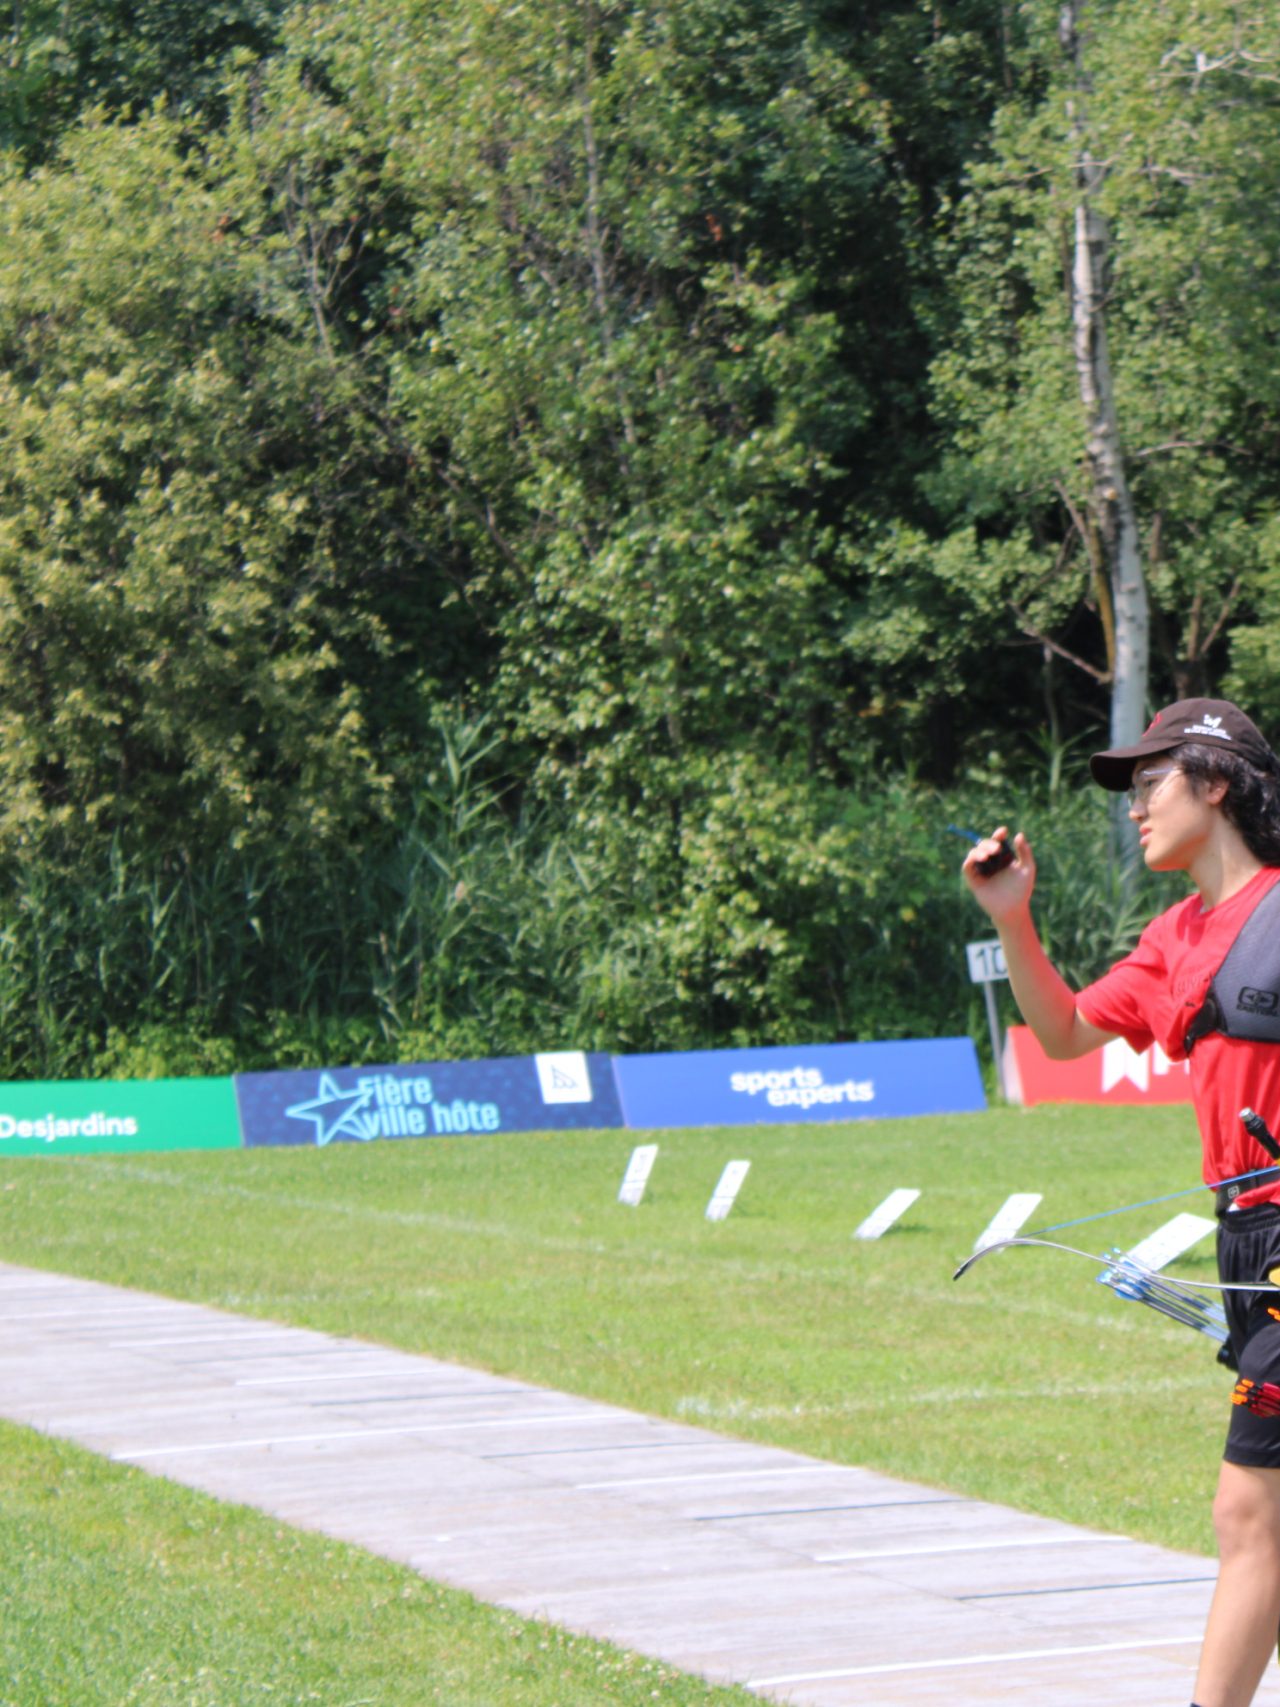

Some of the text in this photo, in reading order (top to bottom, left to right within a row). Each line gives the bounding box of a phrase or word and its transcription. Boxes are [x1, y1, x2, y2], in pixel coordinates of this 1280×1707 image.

[730, 1066, 824, 1096] sports
[767, 1079, 875, 1110] experts
[0, 1112, 138, 1143] Desjardins
[362, 1099, 500, 1138] ville hôte
